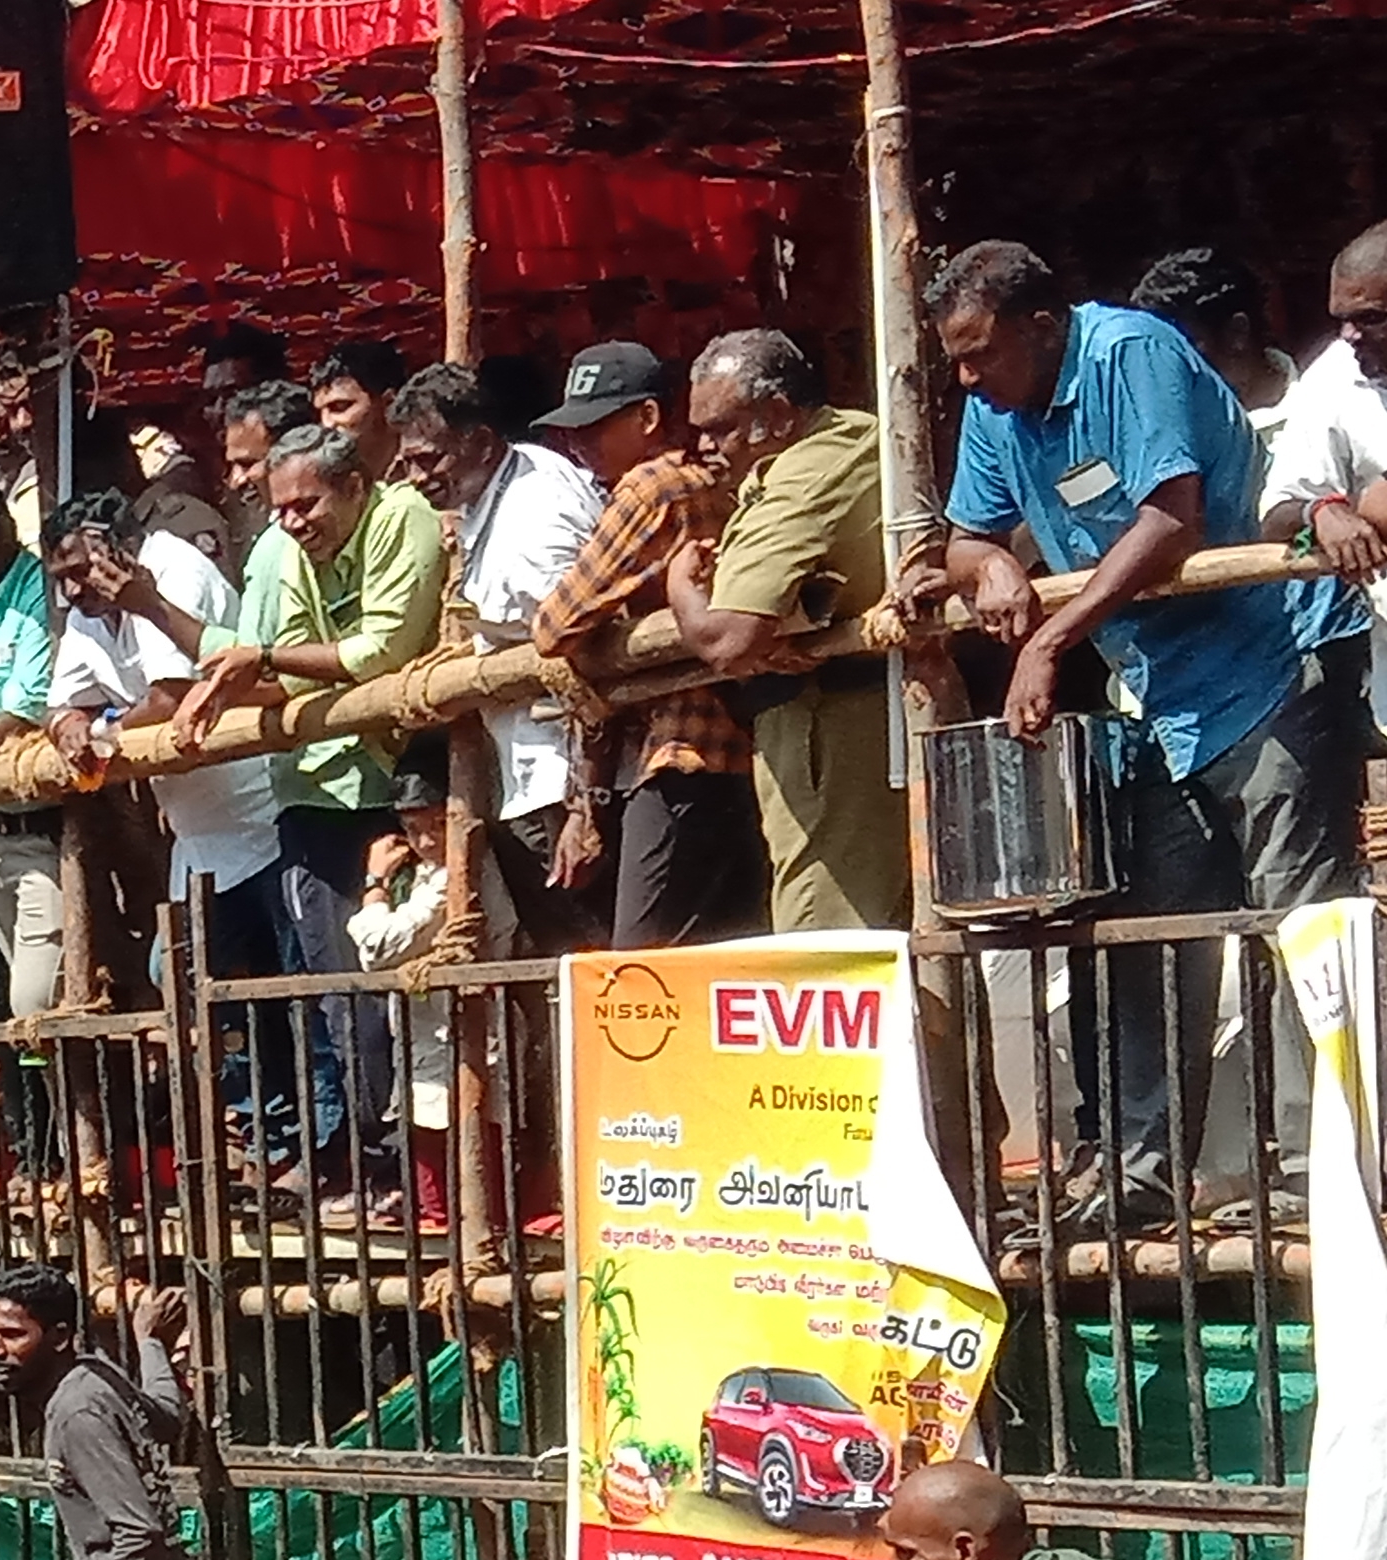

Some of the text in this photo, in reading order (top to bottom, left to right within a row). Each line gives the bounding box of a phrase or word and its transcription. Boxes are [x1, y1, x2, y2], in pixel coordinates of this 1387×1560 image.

[593, 1003, 681, 1020] NISSAN
[715, 987, 882, 1050] EVM
[748, 1083, 767, 1110] A
[771, 1084, 863, 1113] Division
